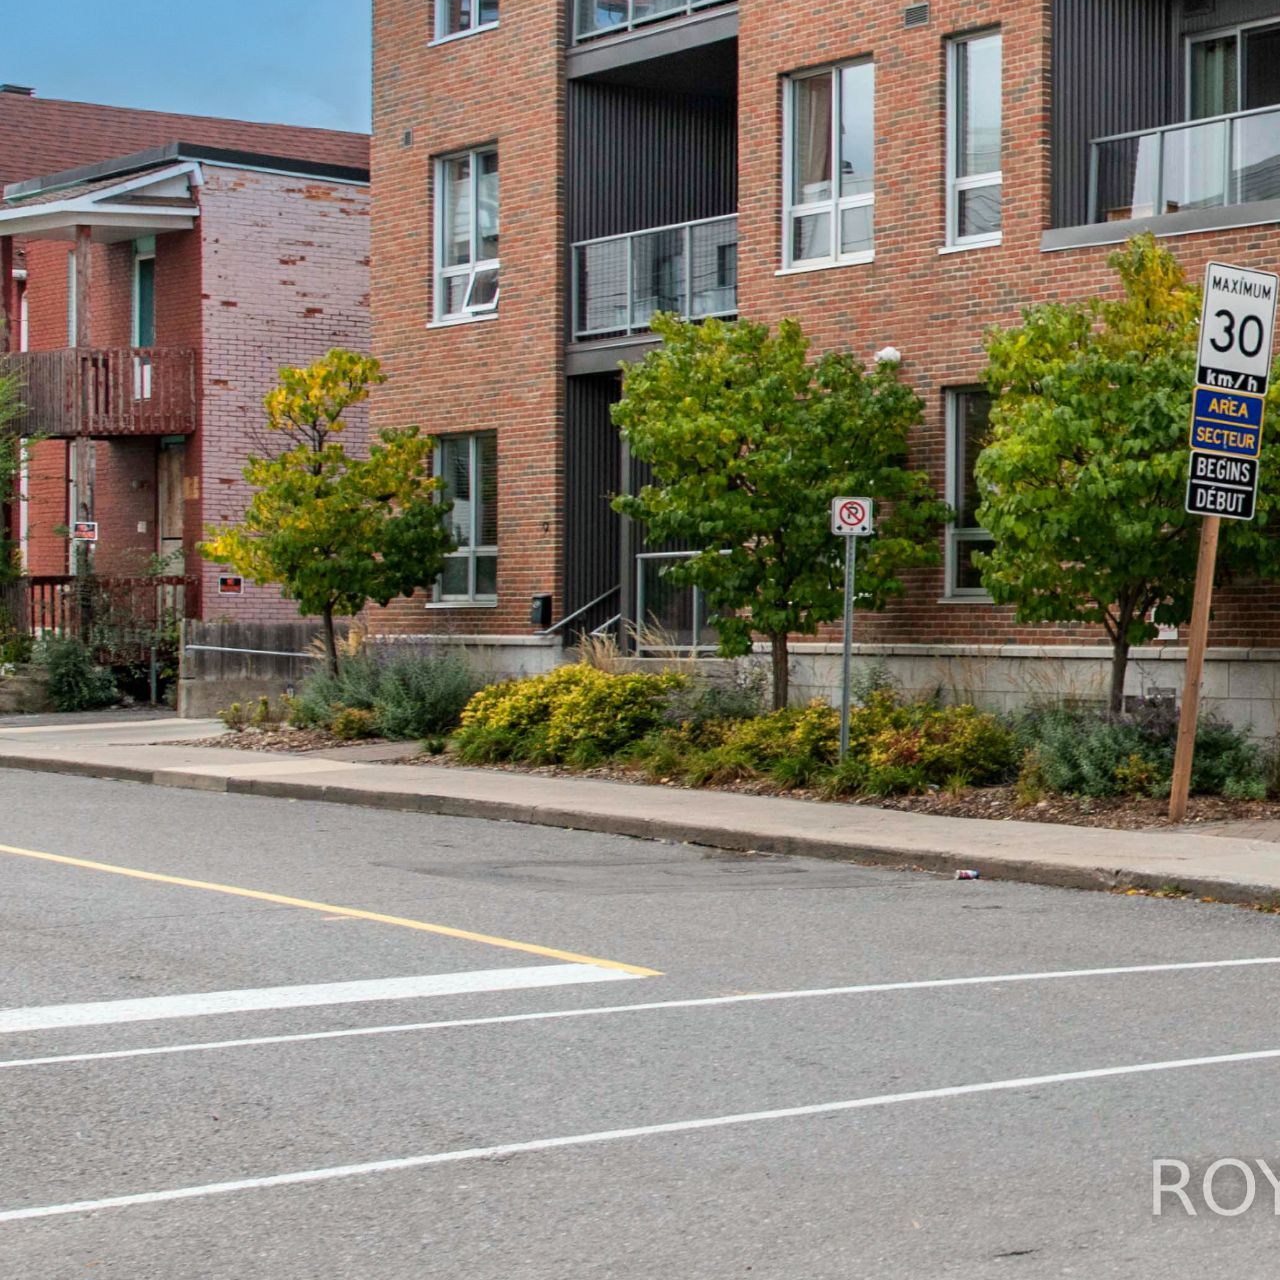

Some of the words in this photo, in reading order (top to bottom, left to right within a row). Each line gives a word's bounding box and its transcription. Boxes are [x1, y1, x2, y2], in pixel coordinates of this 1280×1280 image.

[1212, 275, 1272, 300] MAXIMUM
[1209, 309, 1264, 358] 30
[1205, 368, 1259, 393] km/h
[1207, 398, 1249, 419] AREA
[1196, 426, 1256, 450] SECTEUR
[1196, 456, 1251, 482] BEGINS
[1196, 486, 1246, 513] DÉBUT
